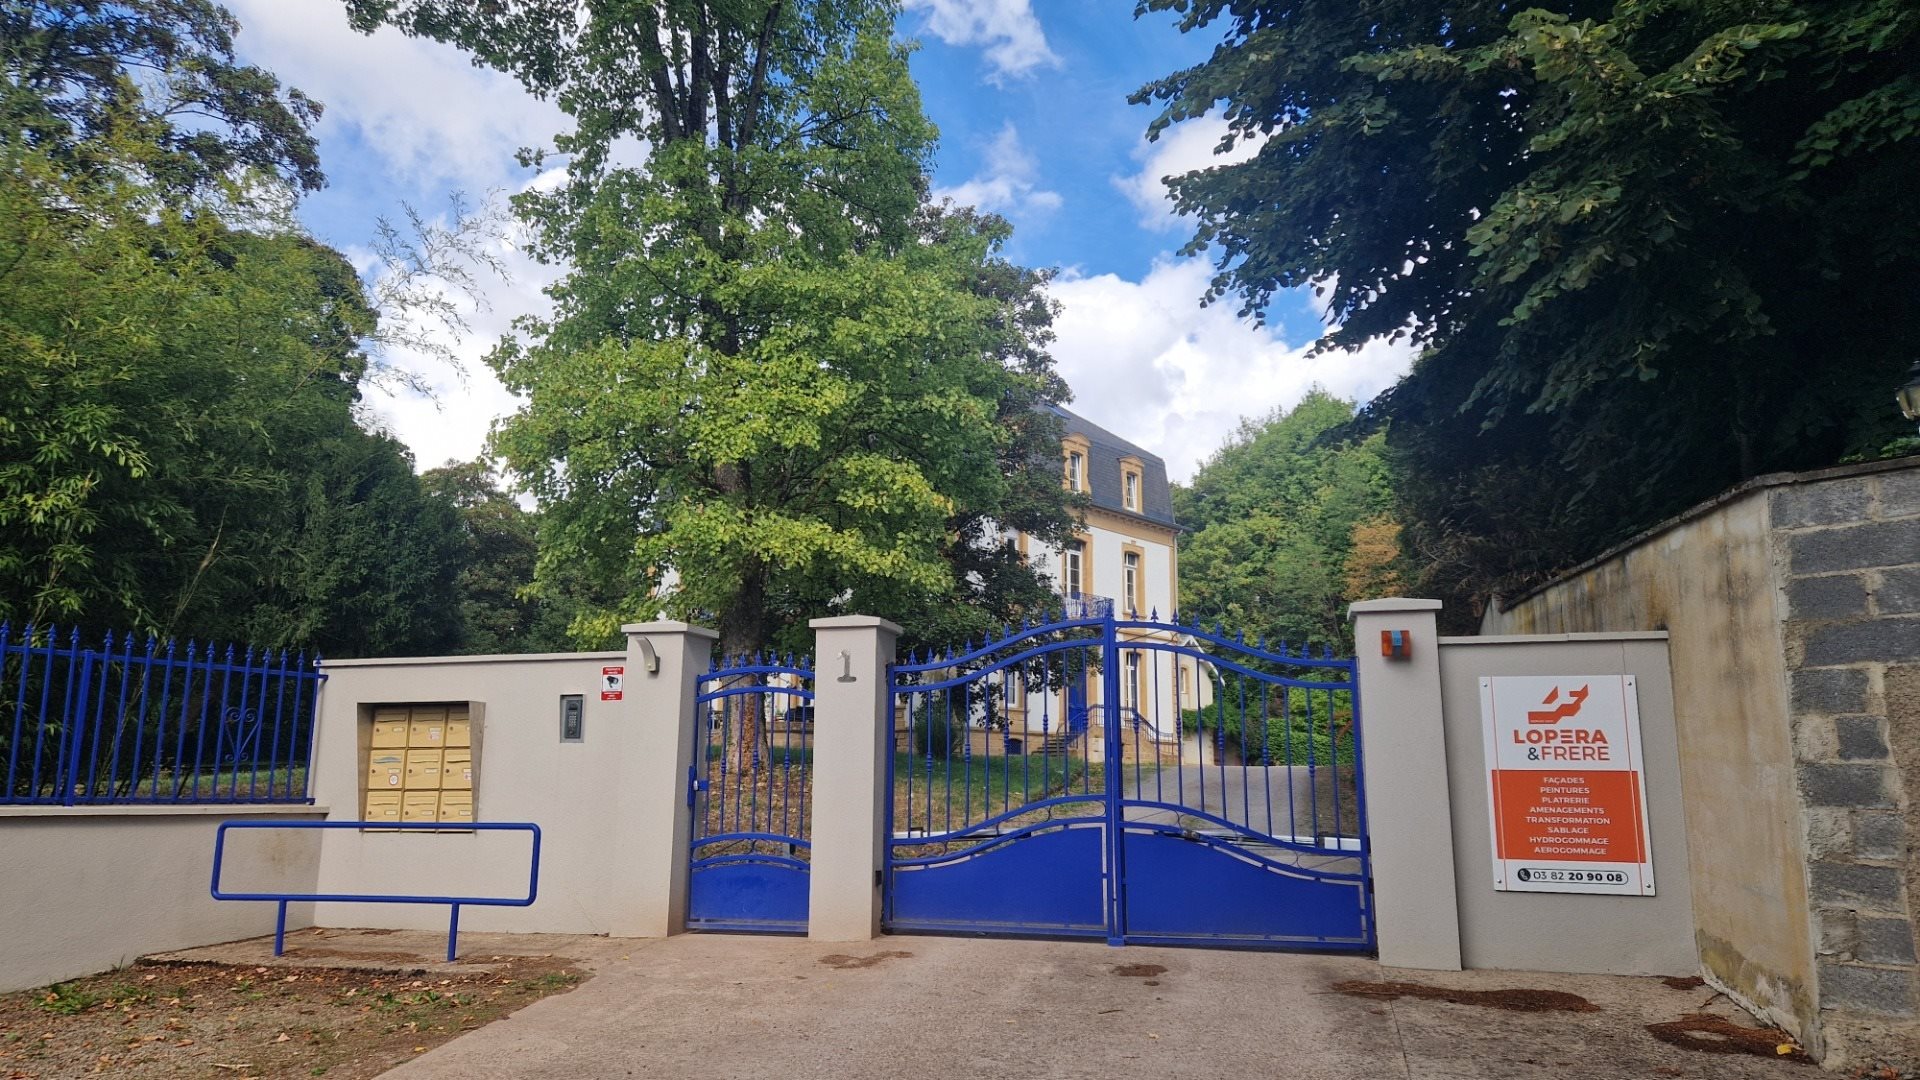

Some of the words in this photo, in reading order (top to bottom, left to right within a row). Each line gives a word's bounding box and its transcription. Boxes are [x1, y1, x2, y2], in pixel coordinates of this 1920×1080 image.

[836, 648, 857, 683] 1
[1513, 729, 1608, 744] LOPERA
[1543, 777, 1585, 785] FAÇADES
[1540, 786, 1590, 794] PEINTURES
[1541, 796, 1590, 804] PLATRERIE
[1529, 806, 1605, 814] AMENAGEMENTS
[1525, 816, 1611, 825] TRANSFORMATION
[1547, 826, 1589, 834] SABLAGE
[1529, 836, 1610, 845] HYDROGOMMAGE
[1534, 846, 1607, 855] AEROGOMMAGE
[1533, 871, 1547, 880] 03
[1550, 872, 1564, 880] 82
[1568, 872, 1583, 881] 20
[1586, 873, 1603, 882] 90
[1606, 873, 1623, 882] 08
